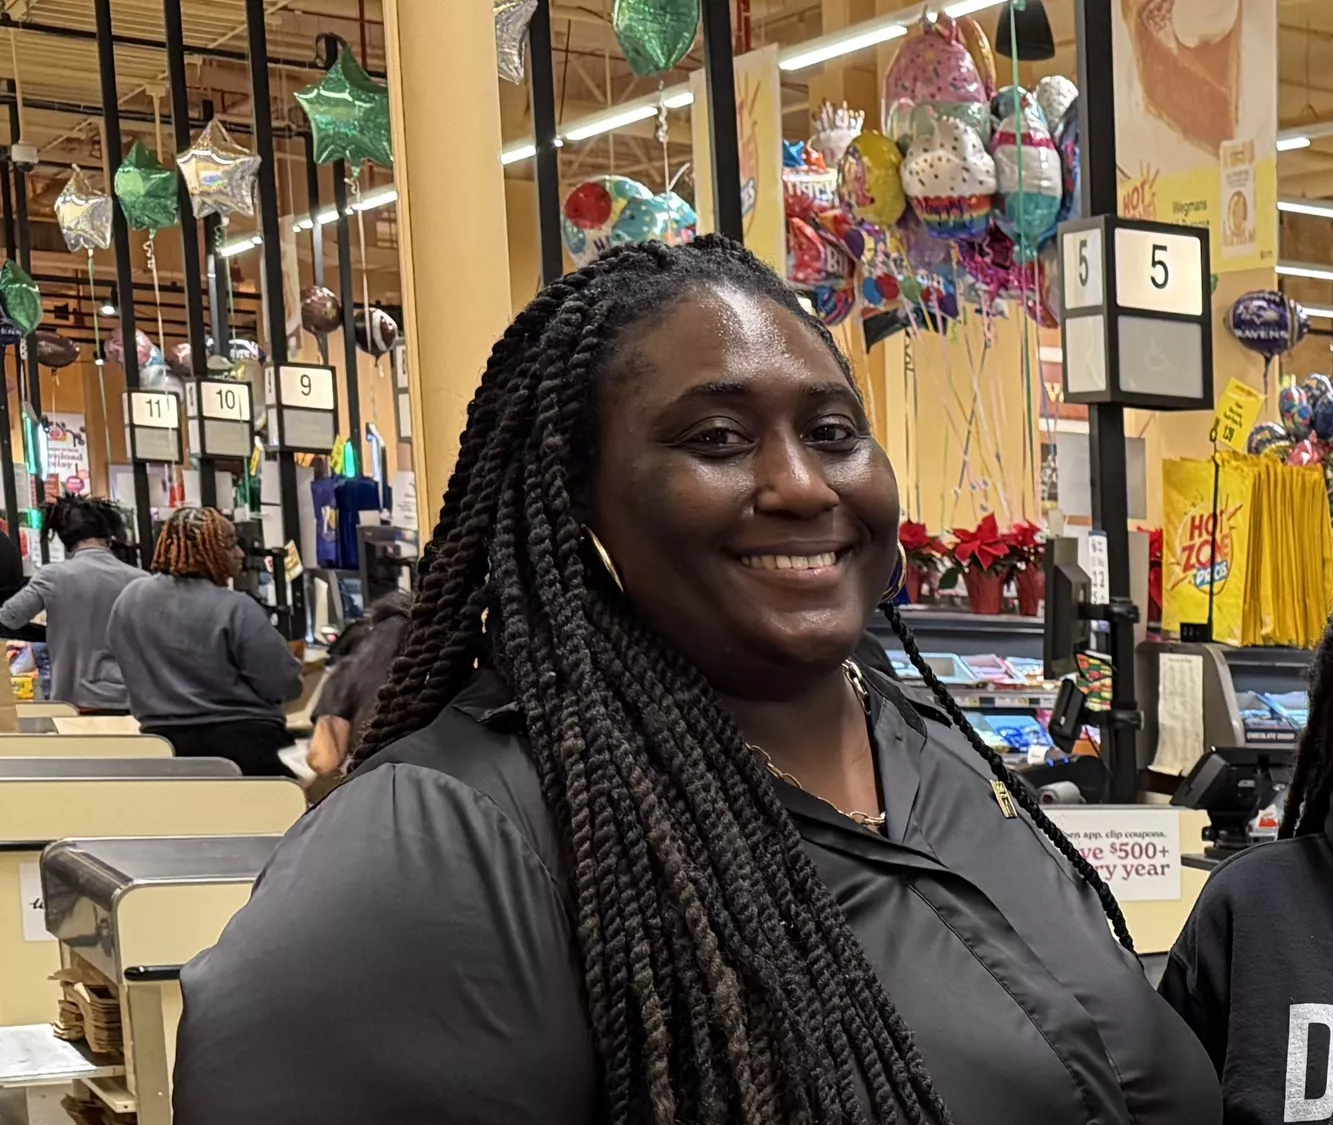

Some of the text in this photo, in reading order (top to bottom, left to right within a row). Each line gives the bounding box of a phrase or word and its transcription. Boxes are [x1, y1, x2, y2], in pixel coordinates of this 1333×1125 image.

[1123, 181, 1147, 213] HOT
[1078, 239, 1088, 287] 5
[1150, 243, 1169, 289] 5
[300, 374, 311, 396] 9
[145, 398, 162, 418] 11
[215, 388, 236, 410] 10
[1190, 509, 1225, 538] HOT
[1181, 535, 1231, 574] ZONE
[1195, 563, 1229, 587] PRCES
[1105, 830, 1122, 839] clip
[1124, 832, 1167, 840] coupons.
[1080, 842, 1169, 860] ve $500+
[1122, 863, 1170, 881] year
